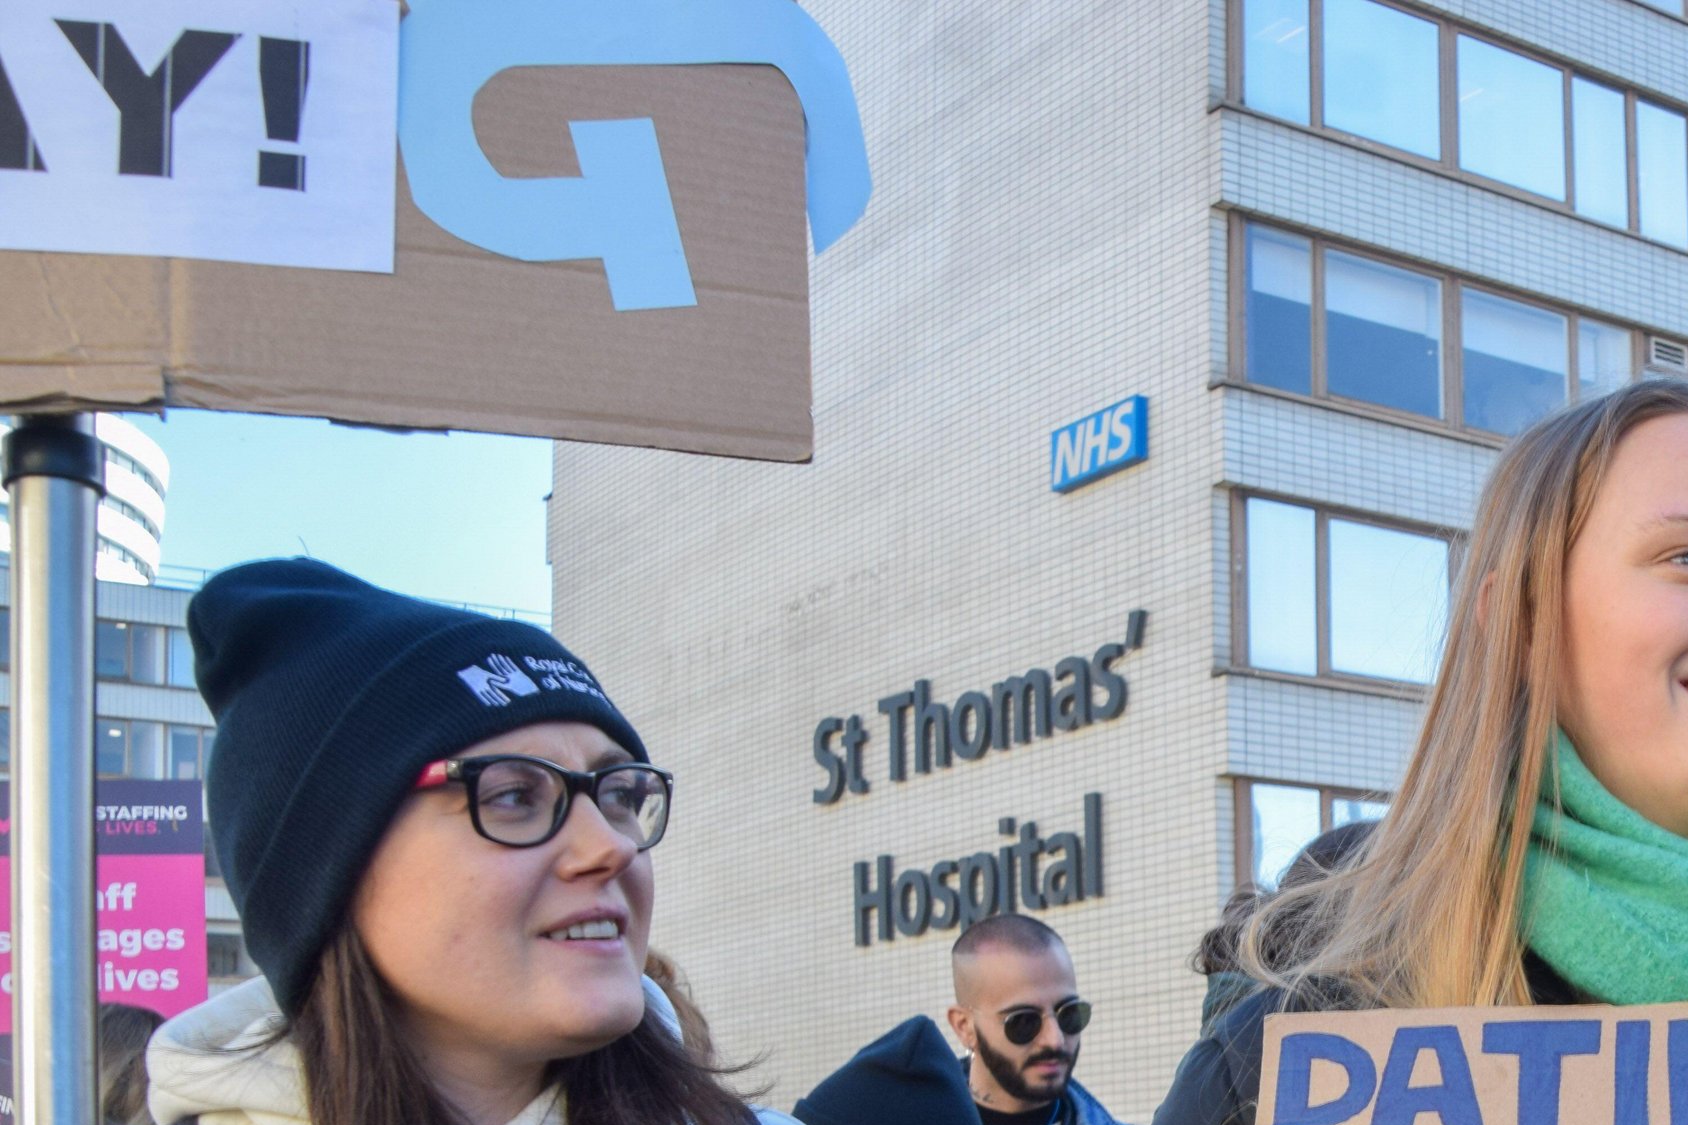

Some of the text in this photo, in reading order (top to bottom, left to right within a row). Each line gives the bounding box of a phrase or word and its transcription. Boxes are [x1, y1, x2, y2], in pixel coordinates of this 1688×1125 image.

[0, 18, 310, 192] Y!
[1053, 401, 1134, 486] NHS
[812, 714, 870, 804] St
[96, 805, 187, 821] STAFFING
[853, 792, 1103, 948] Hospital
[98, 927, 185, 957] ages
